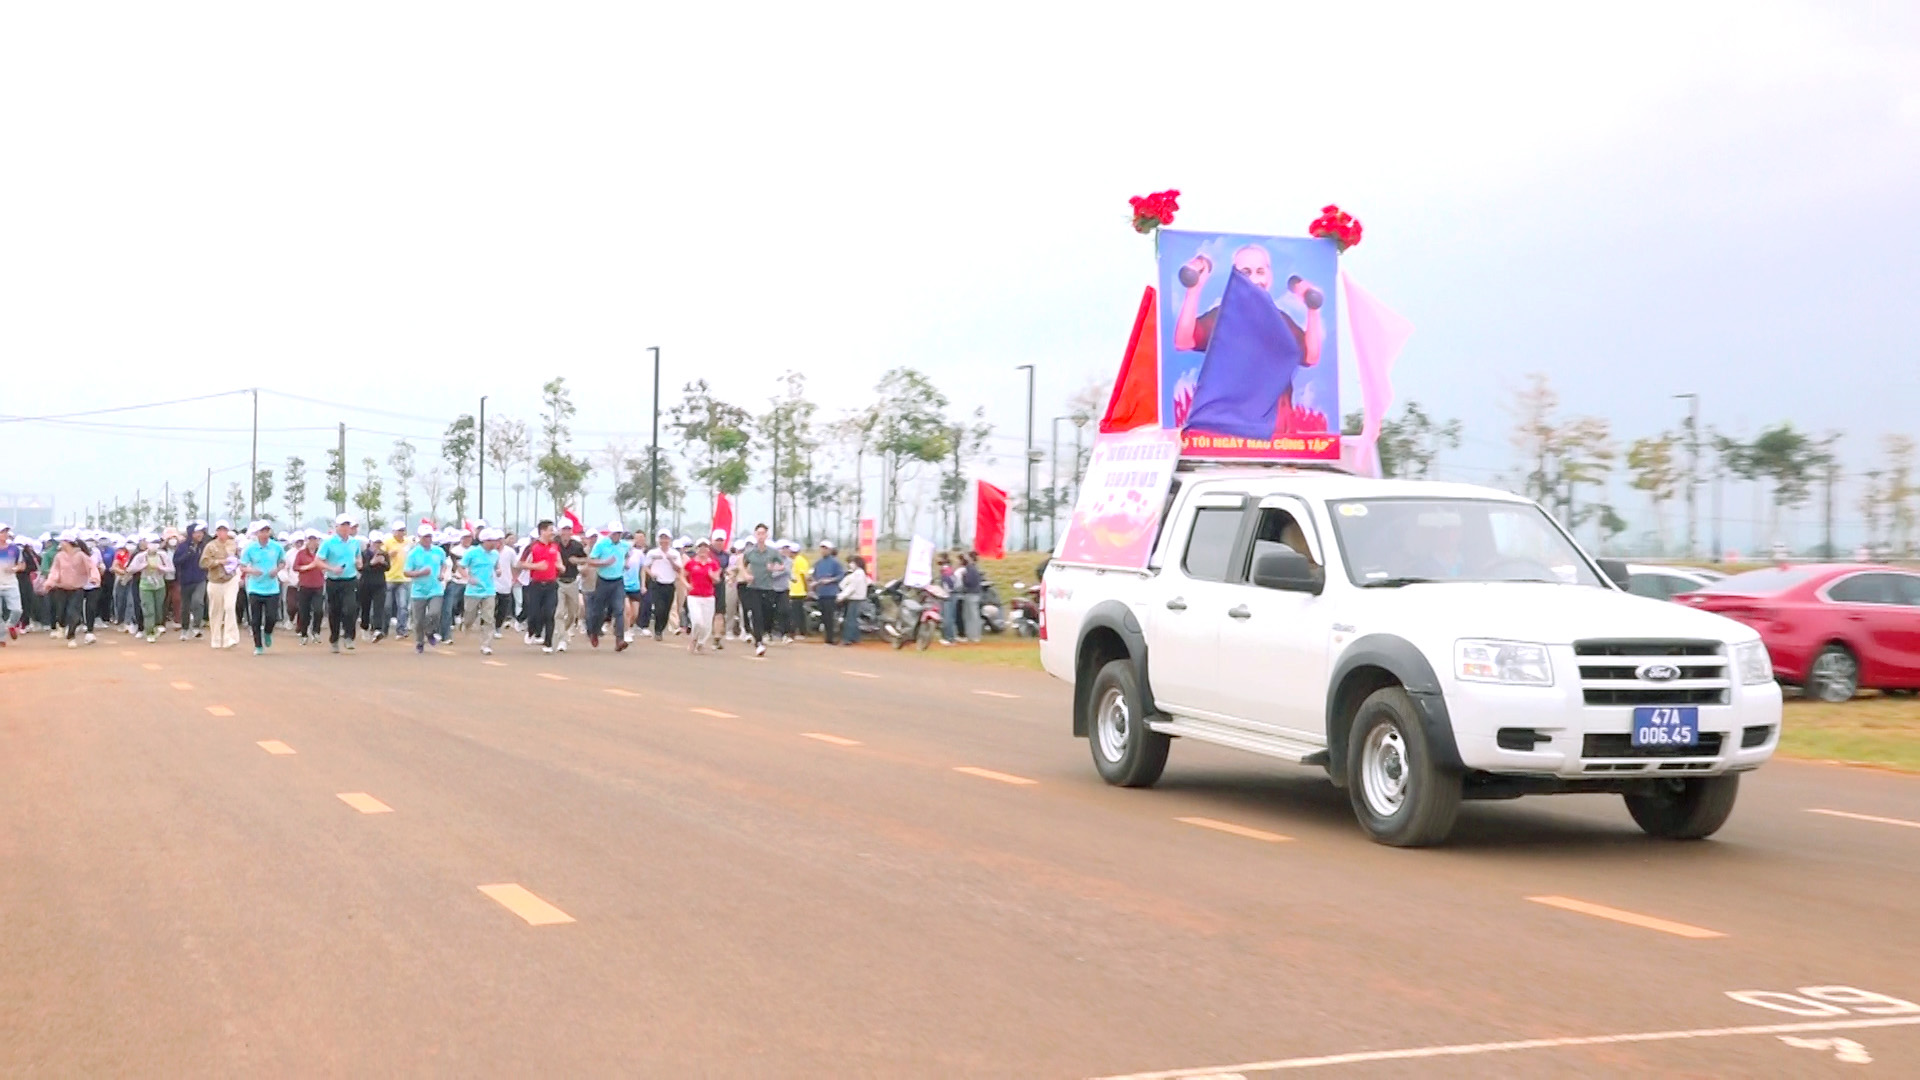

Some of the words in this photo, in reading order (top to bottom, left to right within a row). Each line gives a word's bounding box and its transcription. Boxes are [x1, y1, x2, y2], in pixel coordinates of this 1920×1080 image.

[1192, 437, 1210, 448] TÔI
[1273, 437, 1305, 450] CŨNG
[1648, 666, 1673, 679] Ford
[1651, 709, 1680, 724] 47A
[1639, 726, 1691, 744] 006.45
